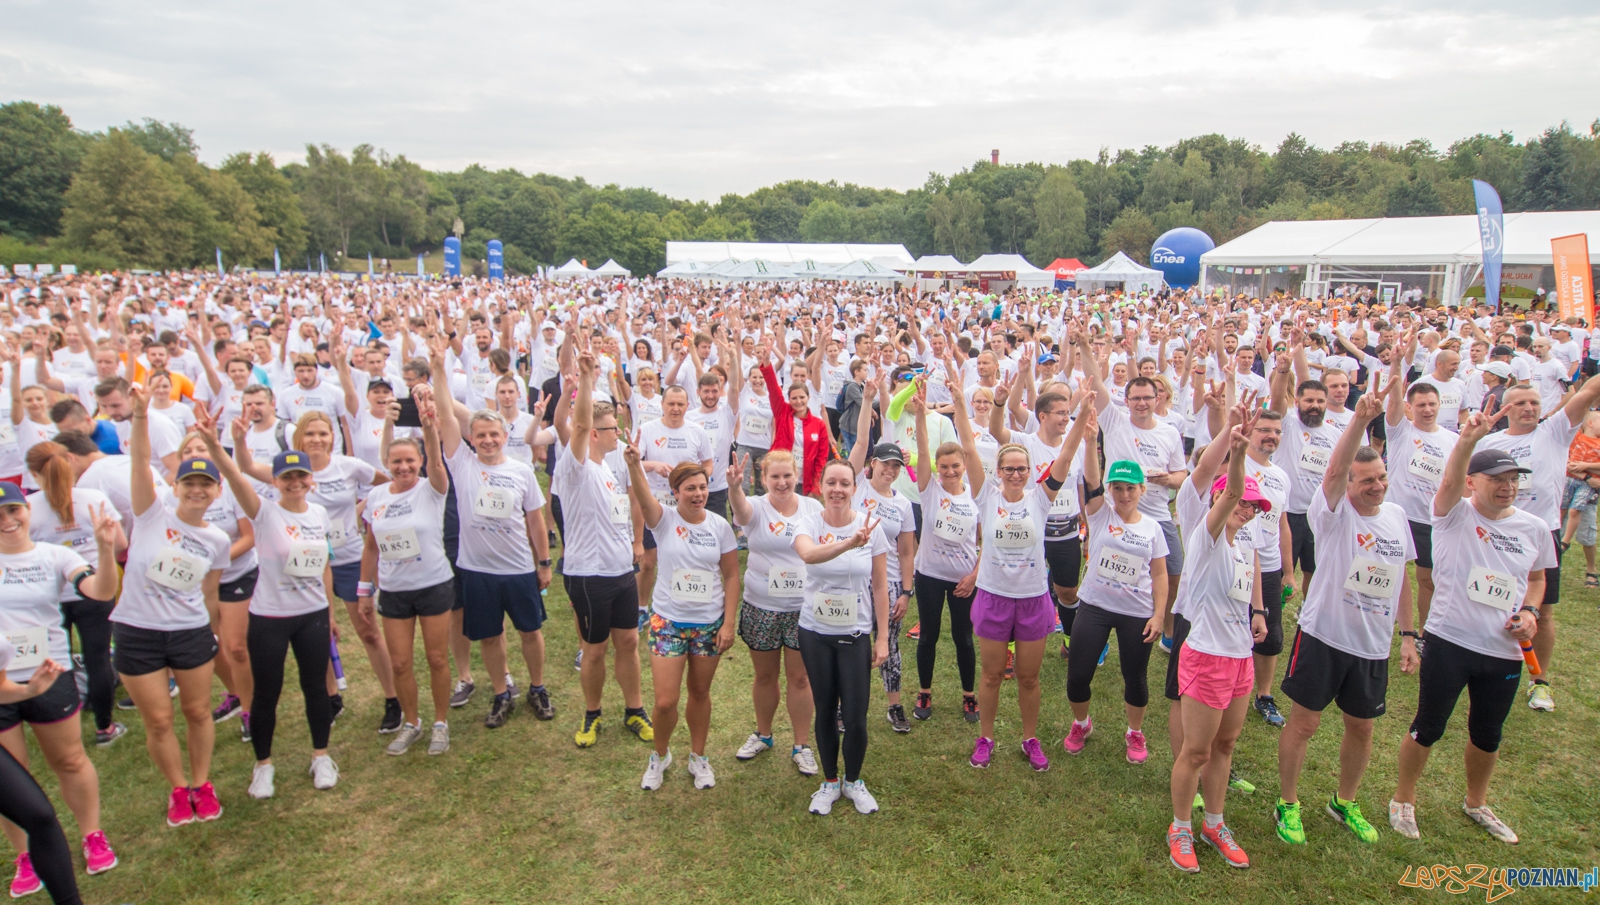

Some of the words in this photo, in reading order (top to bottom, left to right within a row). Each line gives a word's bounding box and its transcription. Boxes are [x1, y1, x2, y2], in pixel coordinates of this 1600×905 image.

[1479, 207, 1494, 251] Enea
[1153, 253, 1186, 264] Enea
[1410, 458, 1442, 476] K506/5
[475, 498, 484, 508] A
[489, 500, 505, 510] 3/3
[935, 519, 943, 530] B
[947, 523, 964, 537] 79/2
[995, 529, 1003, 539] B
[1007, 531, 1029, 541] 79/3
[379, 543, 388, 553] B
[391, 540, 411, 552] 85/2
[1504, 547, 1524, 555] 2016
[1388, 550, 1404, 558] 2016
[287, 556, 299, 568] A
[304, 556, 323, 569] 15/2
[1099, 558, 1136, 577] H382/3
[151, 560, 164, 573] A
[168, 566, 194, 584] 15/3
[770, 578, 779, 589] A
[783, 579, 803, 589] 39/2
[1233, 577, 1242, 589] A
[1349, 570, 1361, 582] A
[1367, 575, 1390, 590] 19/3
[672, 580, 682, 592] A
[685, 582, 707, 594] 39/3
[1468, 580, 1480, 592] A
[1487, 585, 1511, 601] 19/1
[814, 606, 824, 616] A
[827, 607, 850, 618] 39/4
